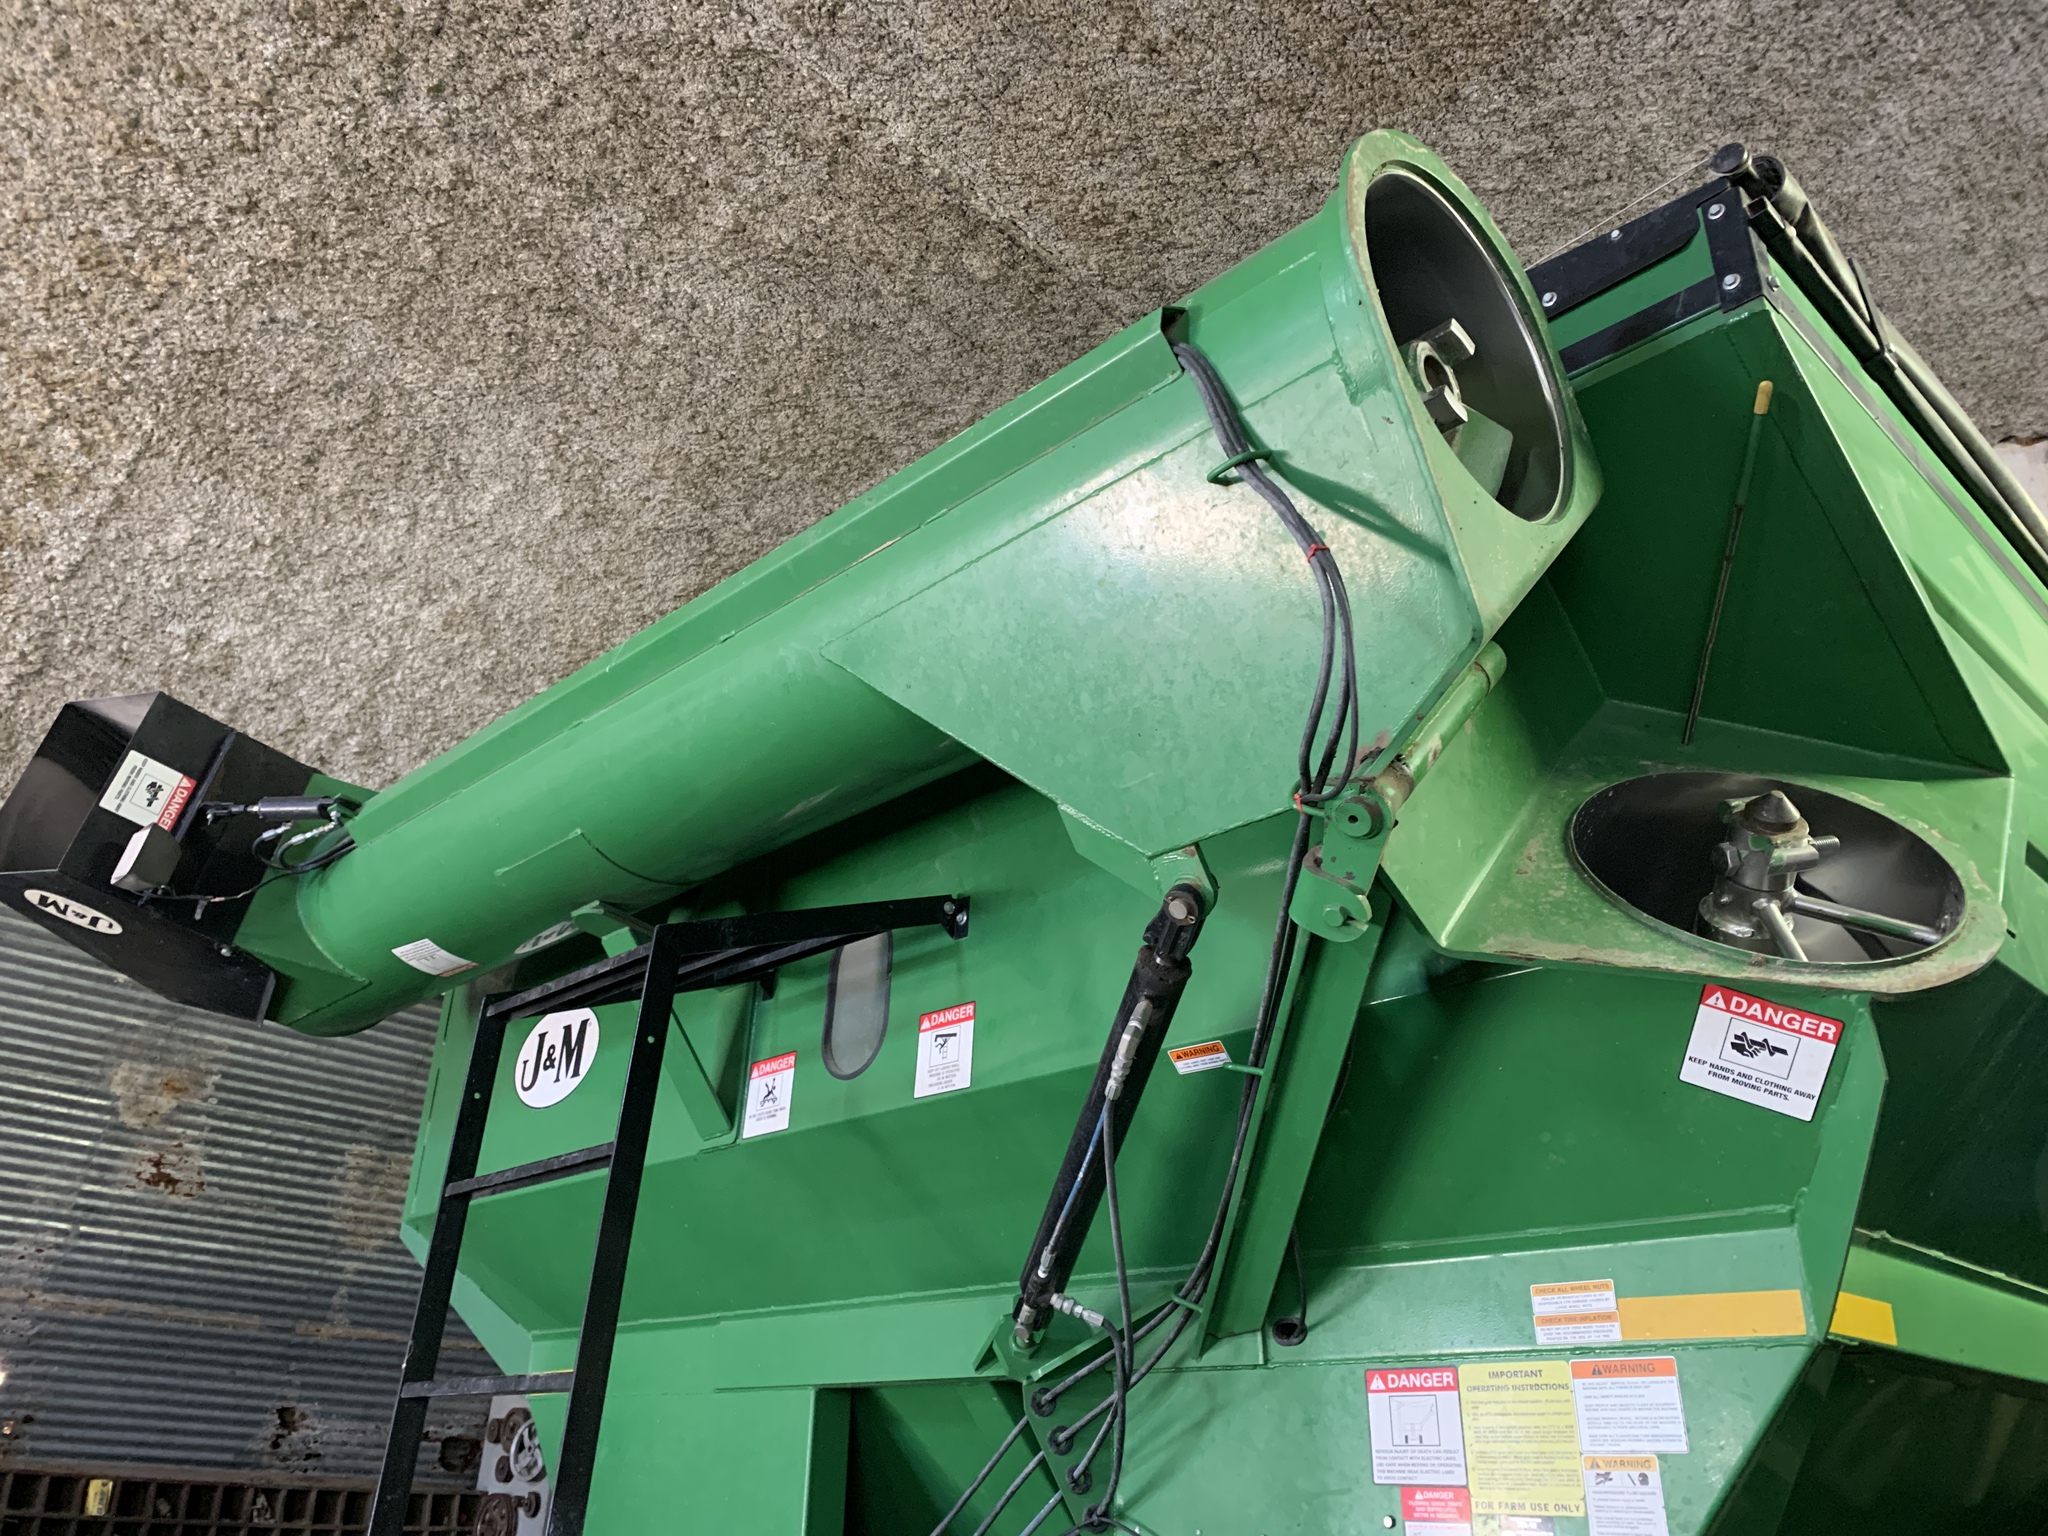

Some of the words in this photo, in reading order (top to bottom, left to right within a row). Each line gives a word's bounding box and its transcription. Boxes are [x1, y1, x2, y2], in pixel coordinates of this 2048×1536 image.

[37, 894, 114, 929] J&M
[930, 1005, 974, 1026] DANGER
[1729, 996, 1837, 1040] DANGER
[521, 1017, 590, 1092] J&M
[1181, 1044, 1220, 1058] WARNING
[759, 1055, 795, 1075] DANGER
[1688, 1055, 1708, 1066] KEEP
[1709, 1061, 1735, 1075] HANDS
[1736, 1070, 1753, 1081] AND
[1755, 1077, 1793, 1094] CLOTHING
[1793, 1089, 1817, 1101] AWAY
[1707, 1070, 1730, 1082] FROM
[1731, 1077, 1762, 1093] MOVING
[1763, 1088, 1790, 1101] PARTS.
[1488, 1370, 1543, 1379] IMPORTANT
[1602, 1363, 1656, 1374] WARNING
[1387, 1372, 1455, 1388] DANGER
[1466, 1384, 1510, 1392] OPERATING
[1512, 1383, 1570, 1392] INSTRUCTIONS
[1603, 1460, 1652, 1469] WARNING
[1423, 1491, 1454, 1500] DANGER
[1475, 1501, 1494, 1510] FOR
[1498, 1502, 1526, 1511] FARM
[1530, 1503, 1550, 1512] USE
[1554, 1504, 1580, 1513] ONLY
